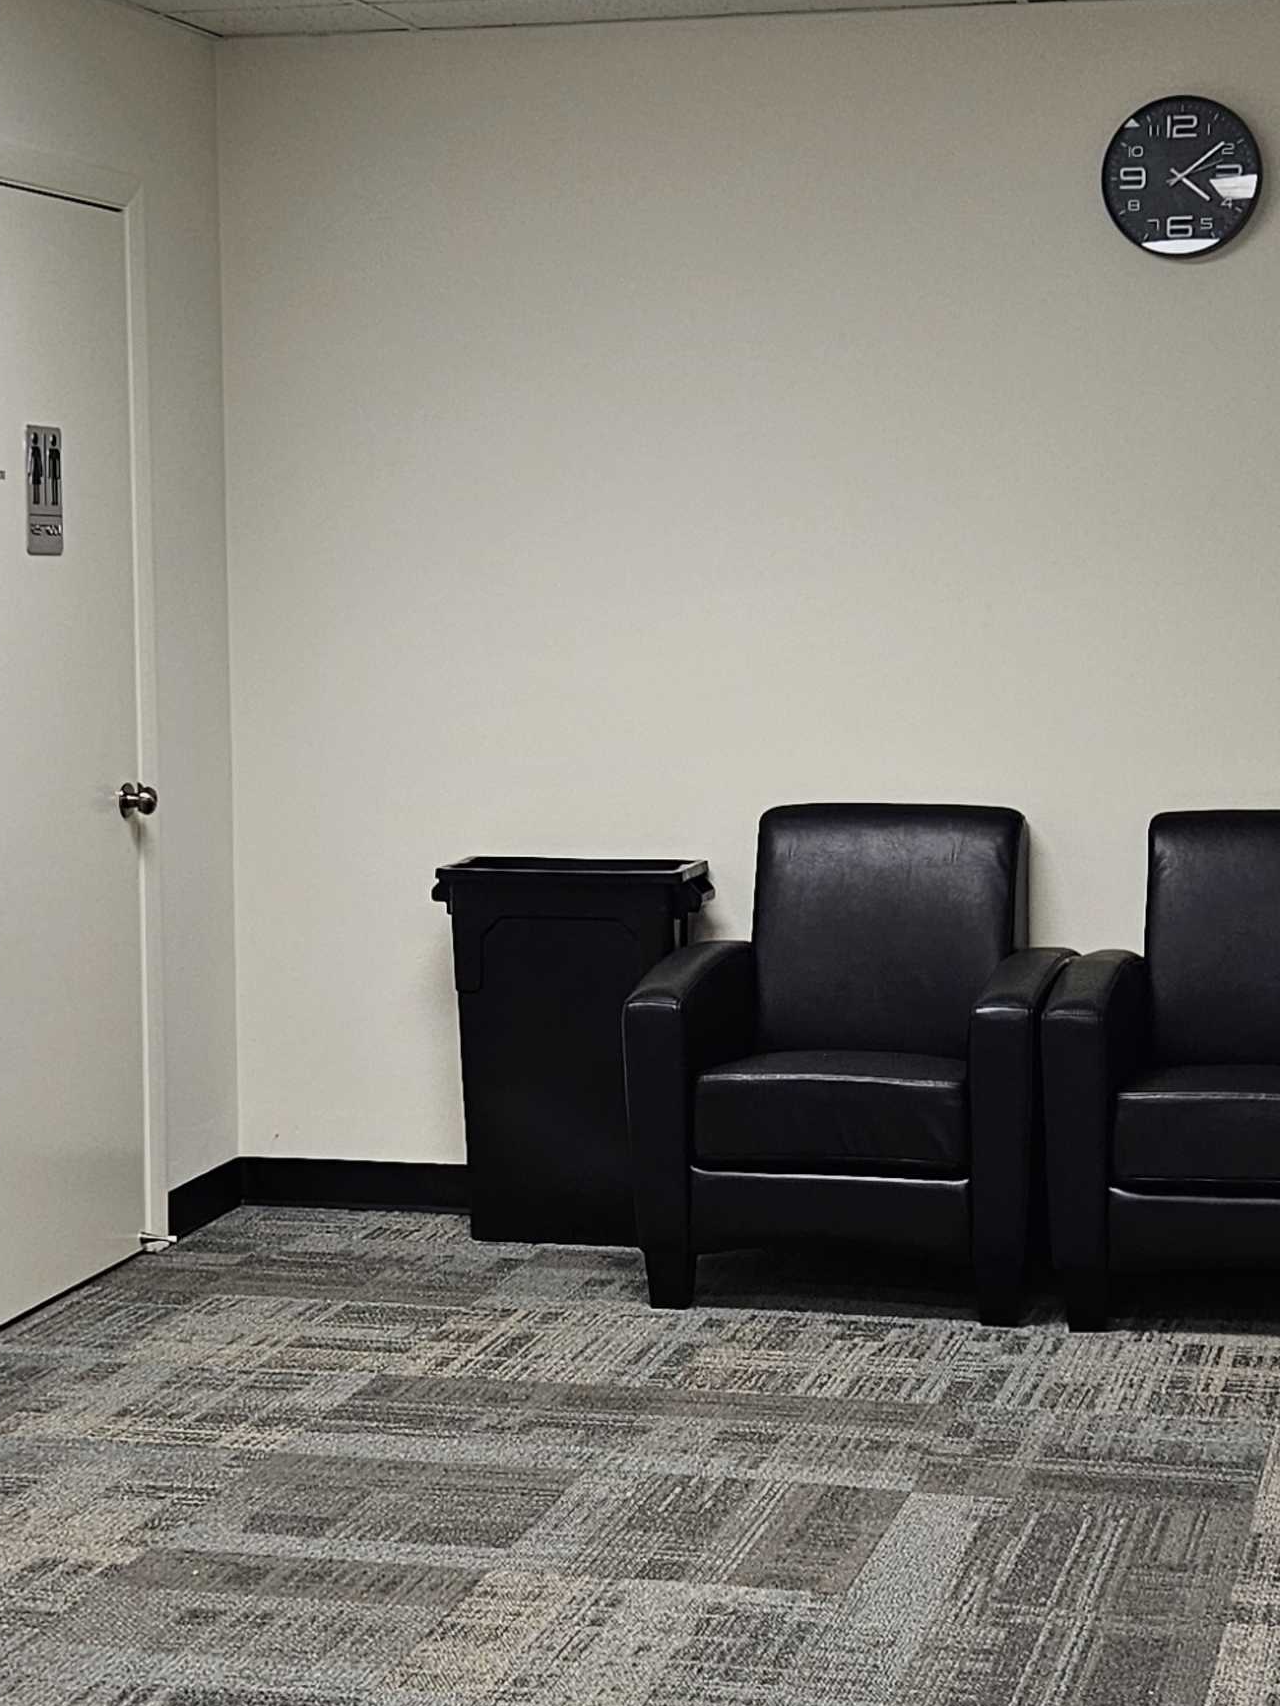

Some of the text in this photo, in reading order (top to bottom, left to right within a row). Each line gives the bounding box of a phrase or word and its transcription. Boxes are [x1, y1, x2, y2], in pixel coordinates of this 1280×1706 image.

[1166, 115, 1198, 138] 12
[1128, 145, 1144, 158] 10
[1221, 142, 1235, 155] 2
[1119, 167, 1146, 189] 9
[1127, 199, 1140, 211] 8
[1220, 196, 1233, 209] 4
[1146, 218, 1160, 231] 7
[1166, 215, 1193, 238] 6
[1200, 217, 1213, 230] 5
